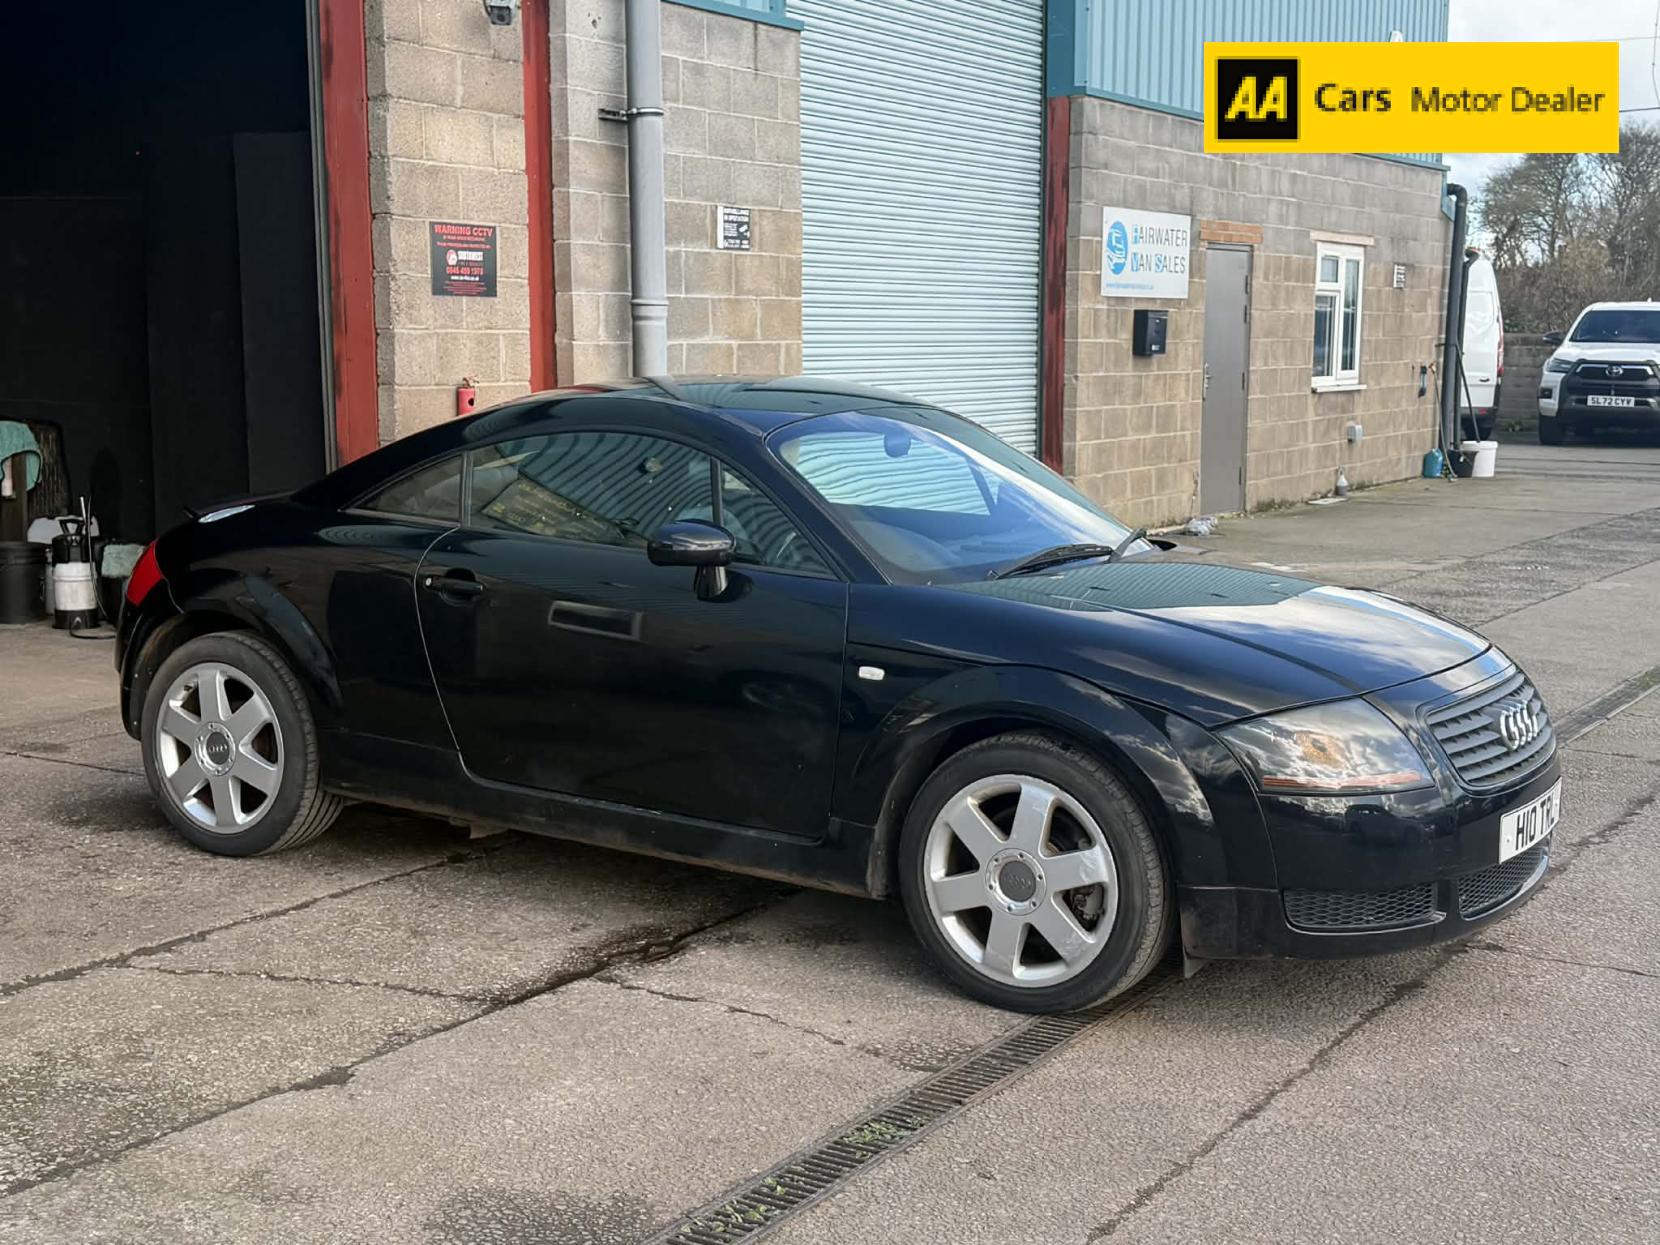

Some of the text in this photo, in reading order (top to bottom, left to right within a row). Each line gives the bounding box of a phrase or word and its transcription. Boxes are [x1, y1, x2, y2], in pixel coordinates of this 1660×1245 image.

[434, 224, 493, 237] WARNING CCTV
[1131, 224, 1187, 247] FAIRWATER
[1131, 252, 1186, 274] VAN SALES
